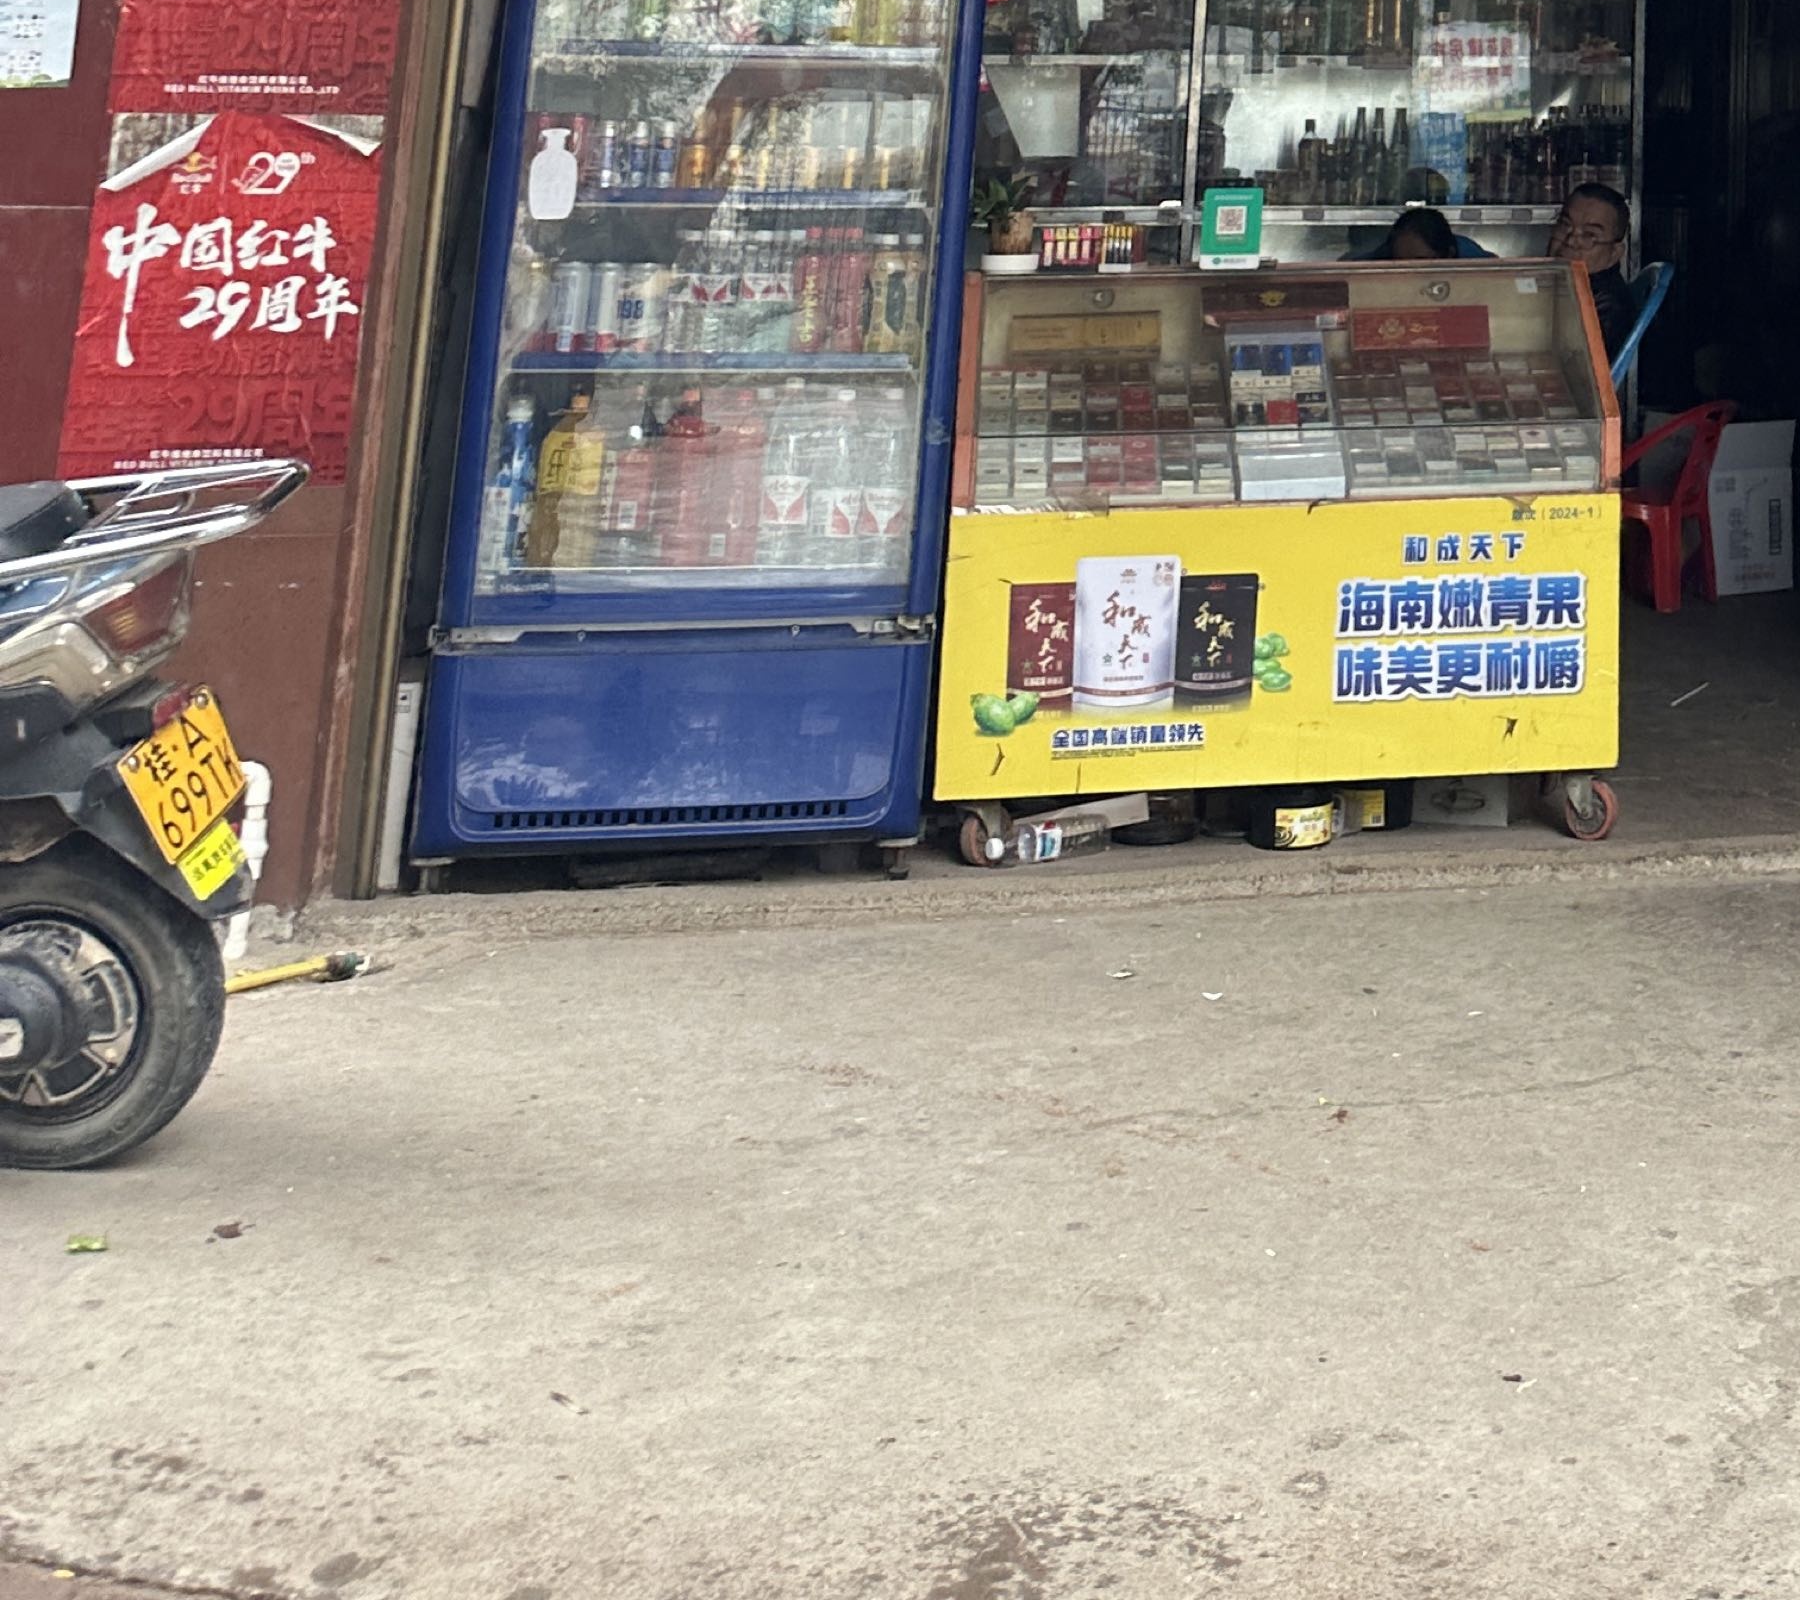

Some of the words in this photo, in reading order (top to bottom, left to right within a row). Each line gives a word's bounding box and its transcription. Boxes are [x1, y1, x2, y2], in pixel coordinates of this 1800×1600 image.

[102, 202, 337, 368] 中国红牛
[178, 274, 360, 343] 29周年
[1404, 532, 1525, 563] 和成天下
[1338, 575, 1584, 633] 海南嫩青果
[1336, 637, 1583, 697] 味美更耐嚼
